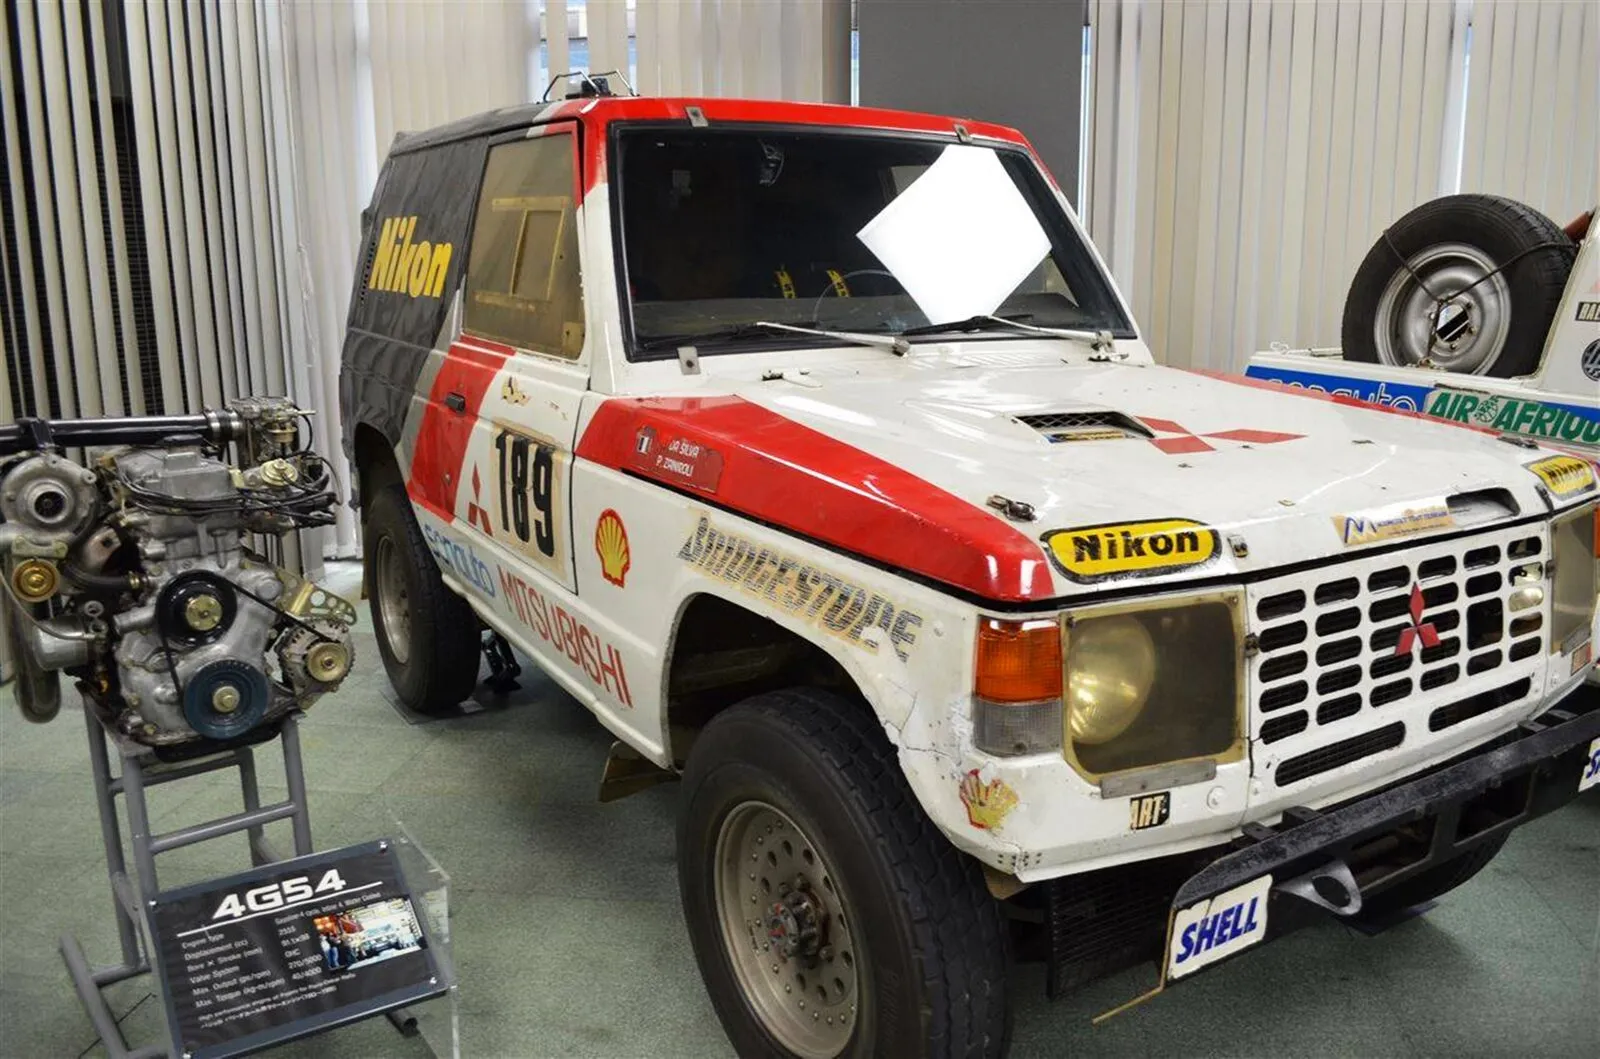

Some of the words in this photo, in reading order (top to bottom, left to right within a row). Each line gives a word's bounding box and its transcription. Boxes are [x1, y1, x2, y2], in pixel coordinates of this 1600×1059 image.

[369, 216, 453, 298] Nikon
[1428, 391, 1479, 424] AIR
[495, 429, 555, 558] 189
[1071, 530, 1200, 563] Nikon
[497, 564, 633, 708] MITSUBISHI
[212, 868, 347, 920] 4G54
[1175, 897, 1258, 964] SHELL
